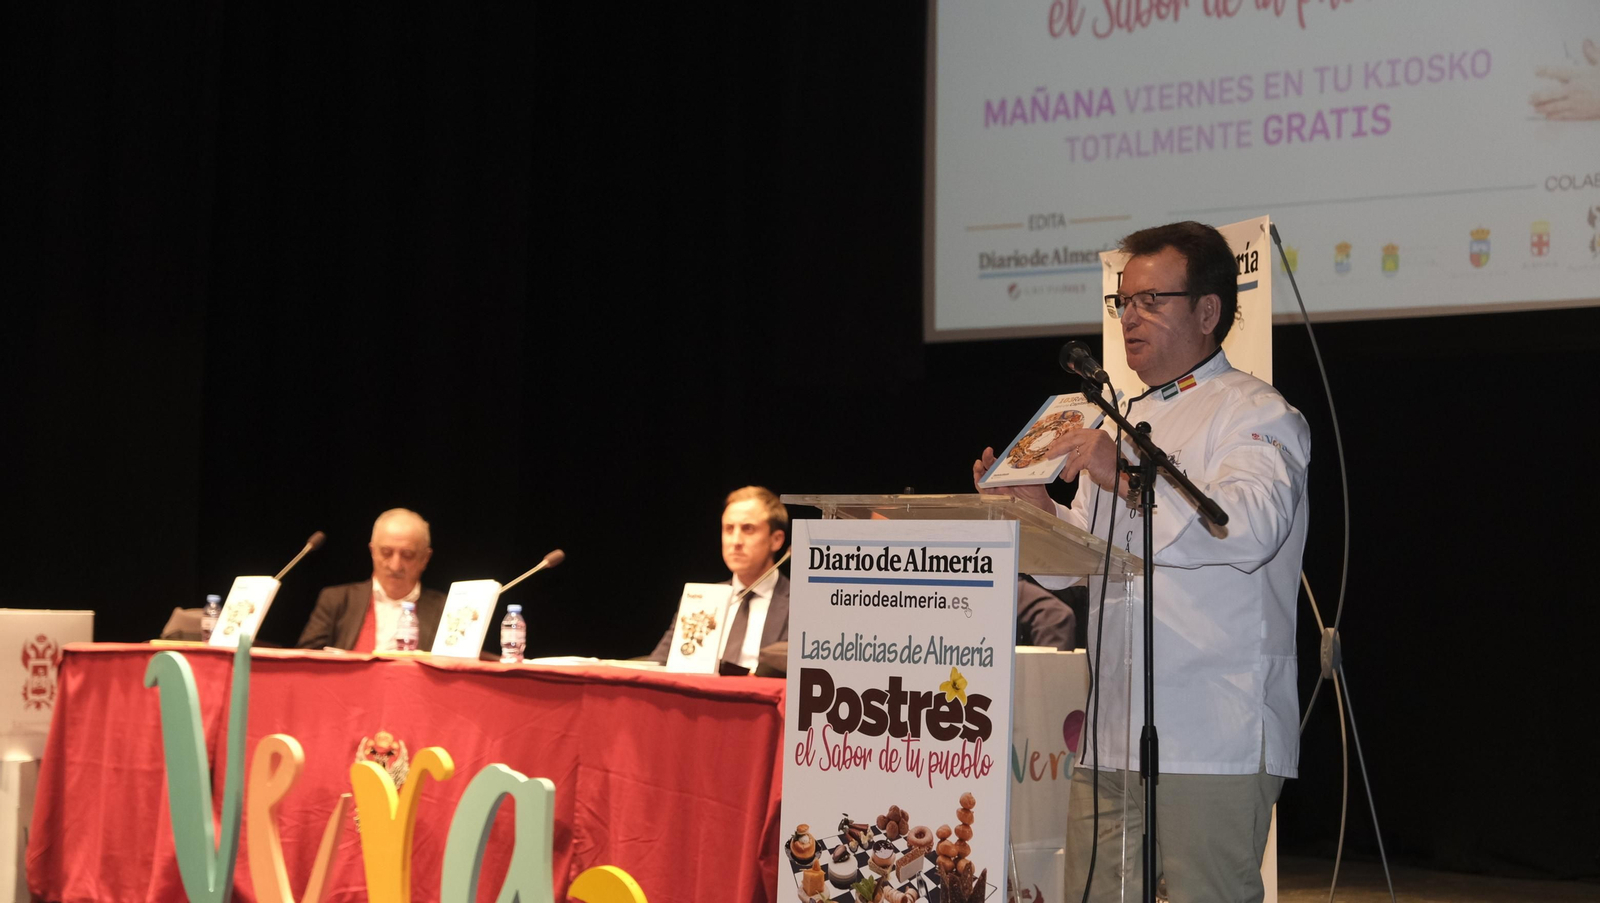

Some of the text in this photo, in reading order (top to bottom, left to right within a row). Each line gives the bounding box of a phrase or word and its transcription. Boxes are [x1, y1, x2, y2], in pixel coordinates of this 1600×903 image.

[984, 48, 1492, 129] MAÑANA VIERNES EN TU KIOSKO
[1065, 103, 1392, 163] TOTALMENTE GRATIS
[1028, 213, 1066, 231] EDITA
[1050, 243, 1108, 265] Almer
[808, 545, 994, 574] Diario de Almería
[830, 589, 969, 610] diariodealmeria.es
[801, 631, 994, 667] Las delicias de Almería
[798, 667, 993, 743] Postres
[144, 632, 556, 903] Vera
[795, 724, 994, 789] el Sabor de tu pueblo
